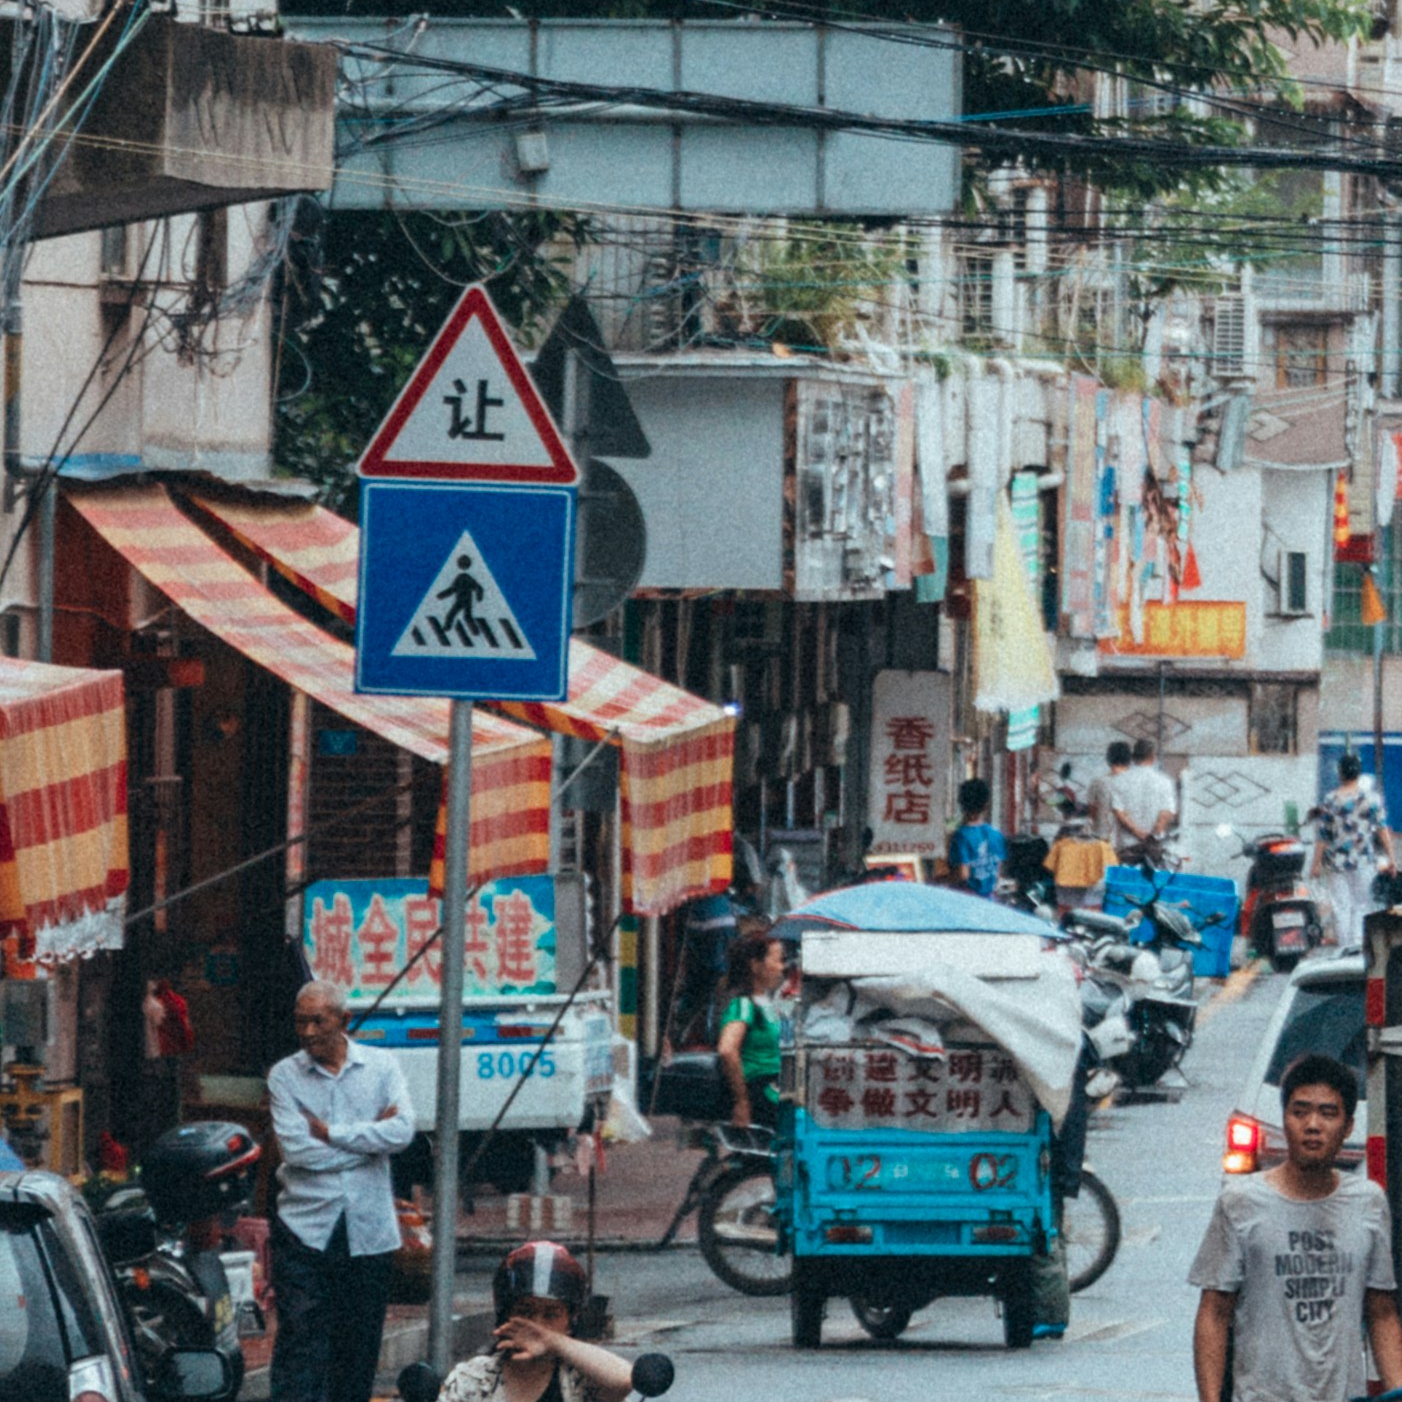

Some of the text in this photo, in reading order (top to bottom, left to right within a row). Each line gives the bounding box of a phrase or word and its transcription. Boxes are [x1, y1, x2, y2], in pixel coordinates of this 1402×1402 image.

[443, 378, 504, 441] 让
[884, 716, 935, 824] 香纸店
[477, 1051, 556, 1080] 8005
[818, 1088, 1023, 1119] 争做文明人
[1295, 1299, 1335, 1323] CITY
